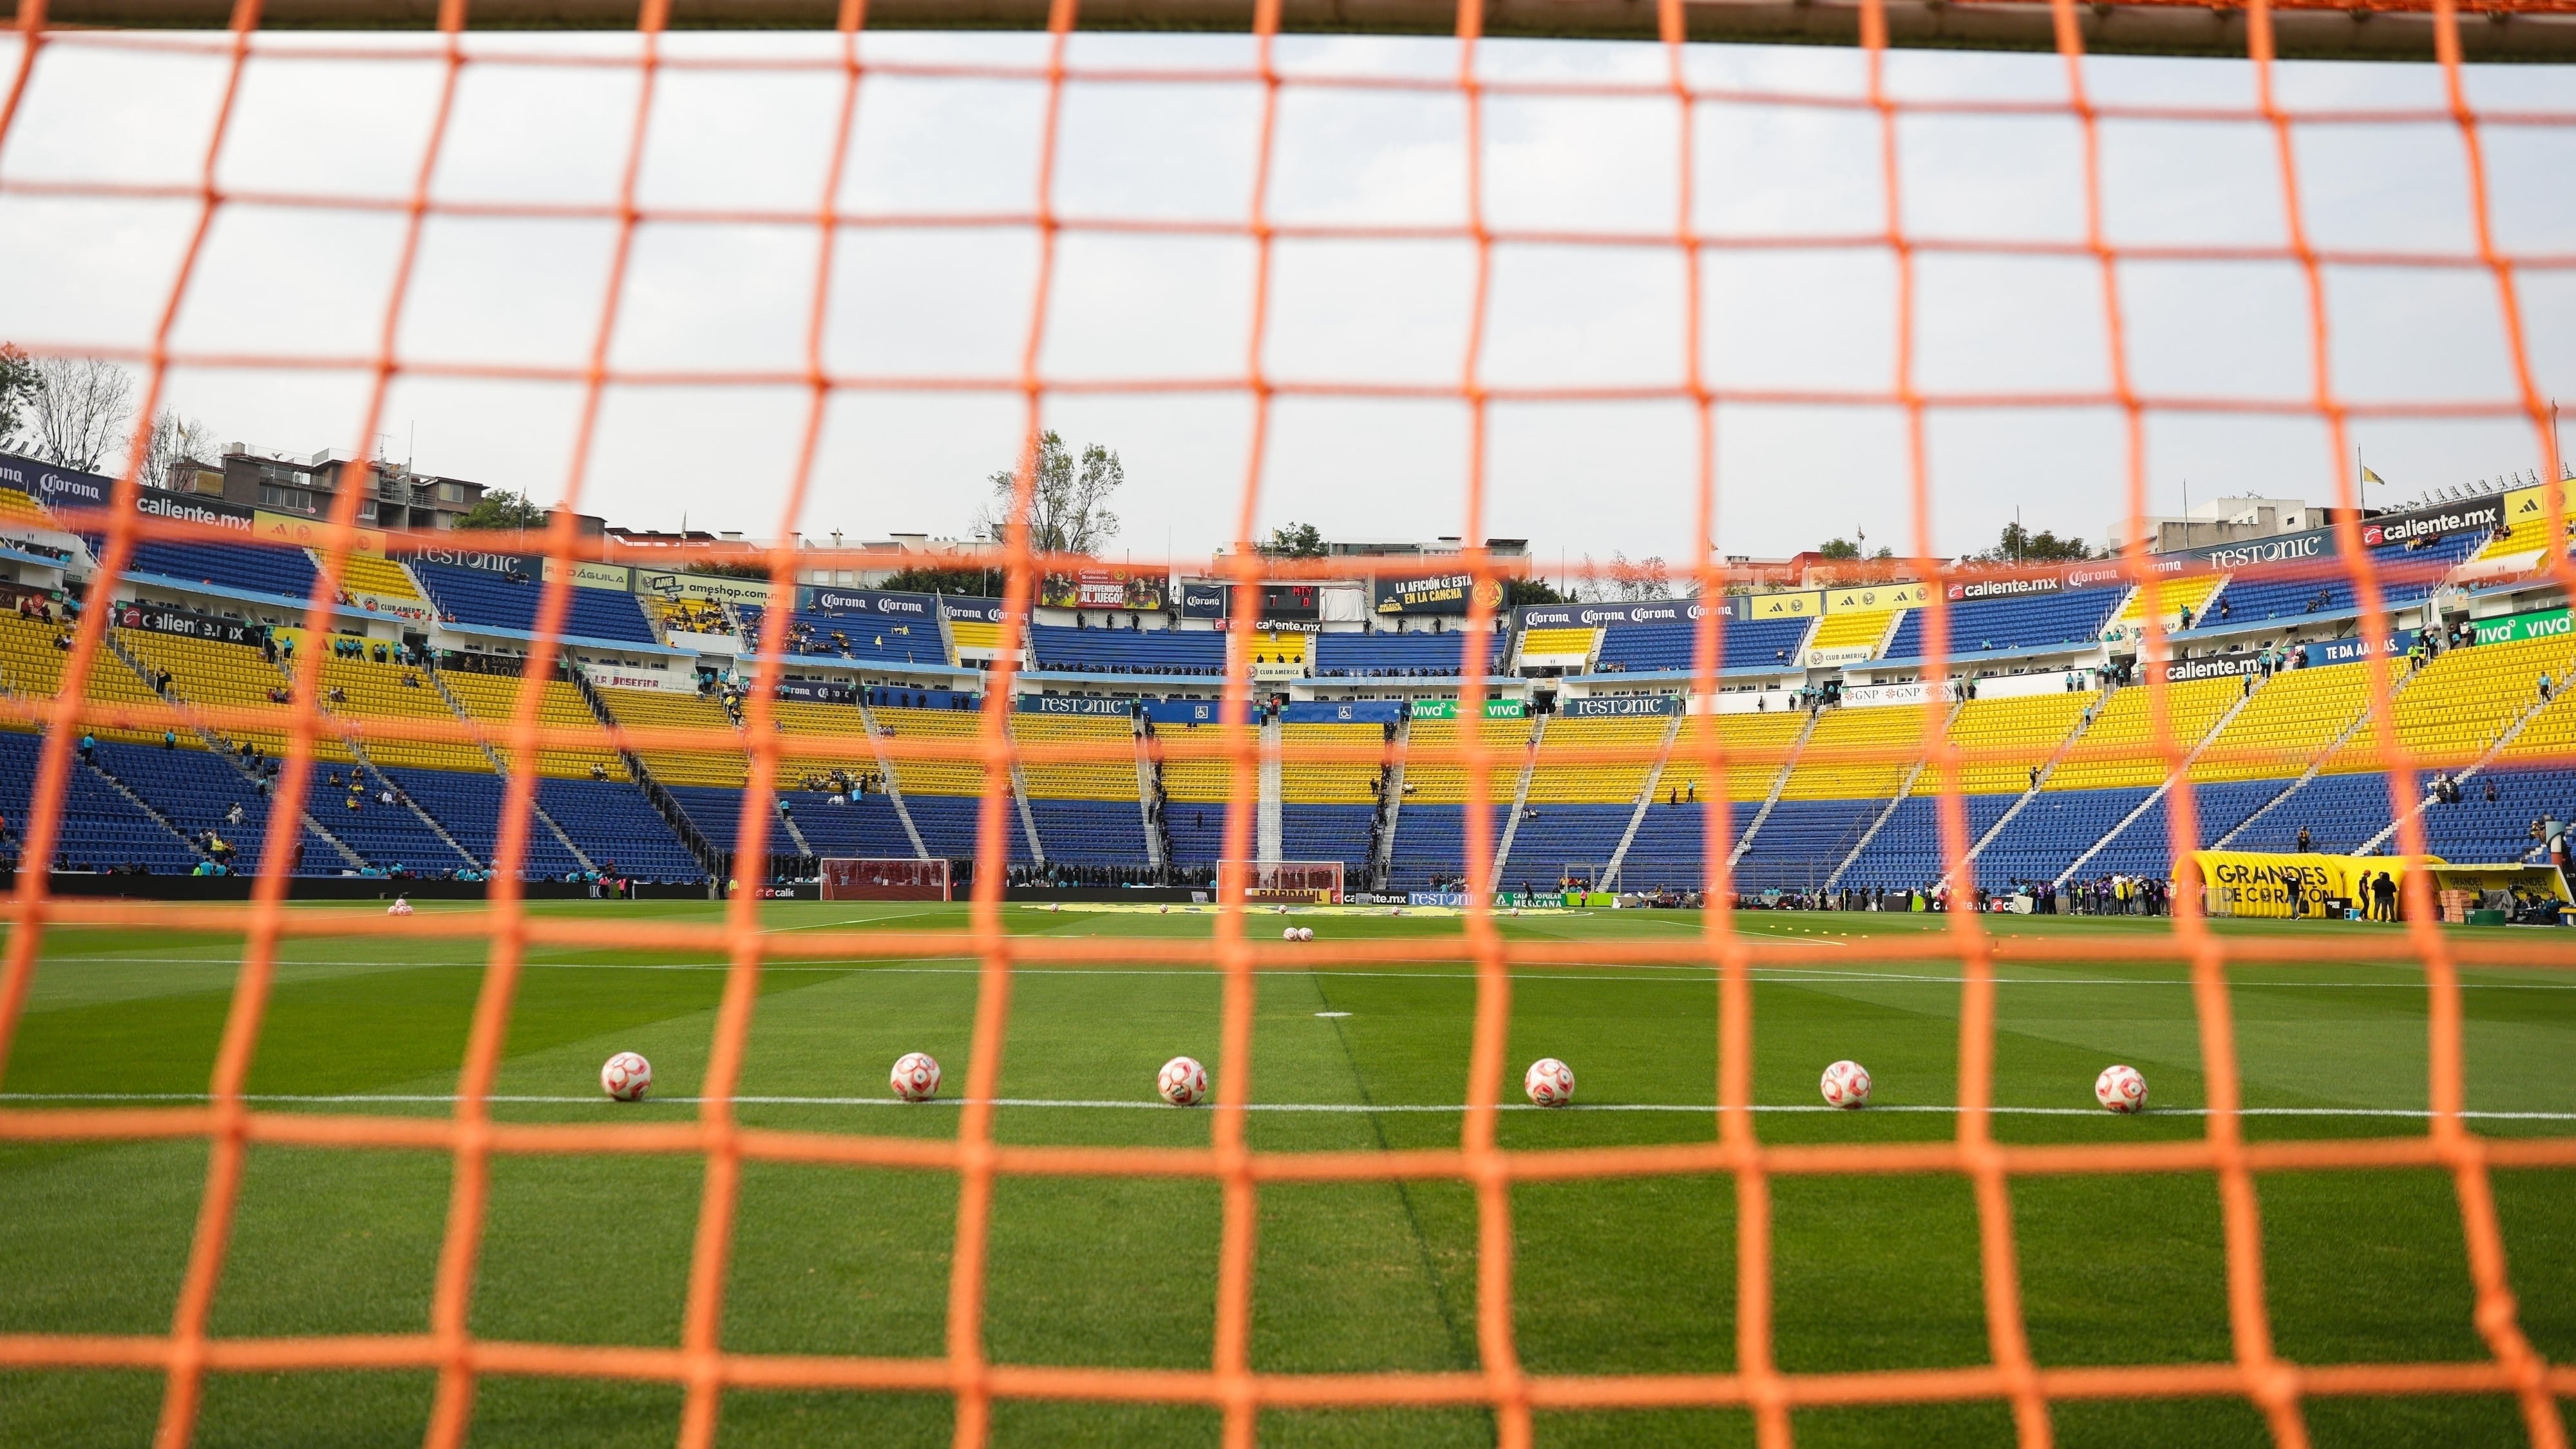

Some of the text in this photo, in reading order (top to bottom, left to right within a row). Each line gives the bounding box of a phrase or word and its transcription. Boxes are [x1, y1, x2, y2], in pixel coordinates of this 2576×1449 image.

[40, 473, 99, 499] Corona
[136, 498, 252, 532] caliente.mx
[2383, 507, 2497, 540] caliente.mx
[2132, 560, 2182, 578] orona
[655, 577, 674, 588] AME
[1396, 582, 1406, 594] LA
[1408, 577, 1440, 592] AFICIÓN
[1453, 573, 1473, 587] ESTÁ
[2069, 570, 2117, 587] Corona
[690, 584, 788, 601] ameshop.com.mx
[1081, 583, 1123, 592] ¡BIENVENIDOS
[1293, 586, 1313, 596] MTY
[1965, 577, 2058, 597] caliente.mx
[821, 593, 923, 614] Corona Corona
[1081, 592, 1123, 603] AL JUEGO!
[1187, 596, 1220, 607] Corona
[1405, 593, 1416, 604] EN
[1418, 591, 1428, 603] LA
[381, 603, 399, 612] CLUB
[943, 605, 982, 620] Corona
[1526, 611, 1570, 627] Corona
[1581, 609, 1625, 625] Corona
[1631, 607, 1676, 623] Corona
[142, 613, 244, 641] caliene.x
[2526, 616, 2571, 638] viva
[2326, 639, 2400, 659] TE DA AAAAS.
[491, 657, 521, 665] SANTO
[595, 675, 607, 684] LA
[1855, 690, 1879, 700] GNP
[1897, 688, 1920, 698] GNP
[1411, 705, 1519, 716] viva viva
[2217, 864, 2328, 886] GRANDES
[2449, 876, 2483, 886] GRANDES
[1344, 893, 1406, 904] cante.mx
